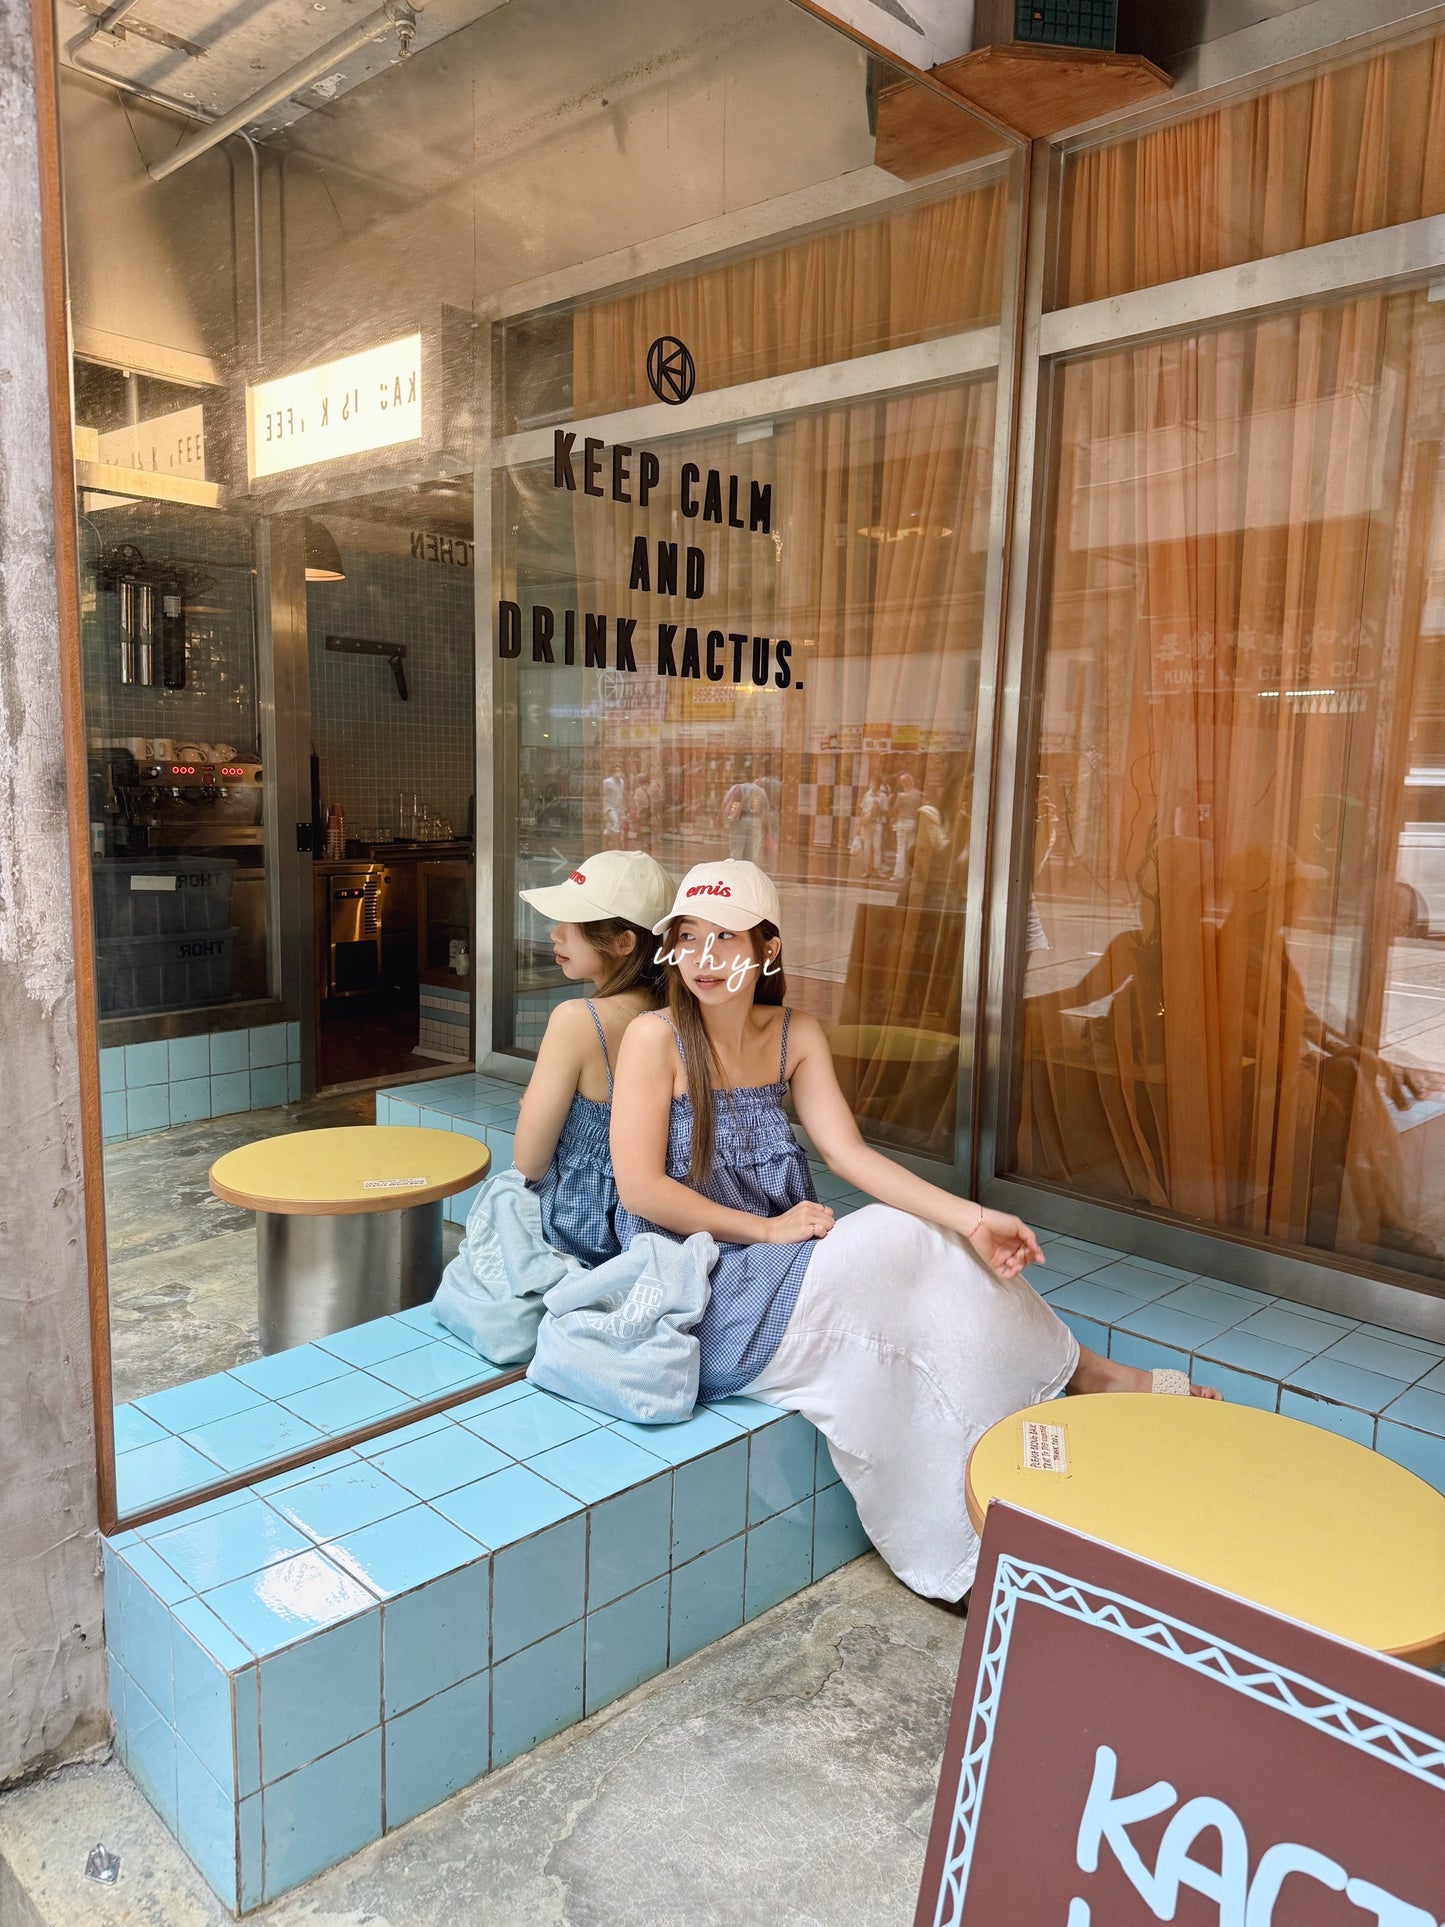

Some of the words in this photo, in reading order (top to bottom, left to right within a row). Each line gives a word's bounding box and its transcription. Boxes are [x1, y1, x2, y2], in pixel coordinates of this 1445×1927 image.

[554, 429, 660, 507] KEEP
[680, 463, 772, 534] CALM
[629, 535, 705, 600] AND
[499, 600, 637, 673] DRINK
[657, 623, 804, 690] KACTUS.
[686, 880, 732, 898] emis
